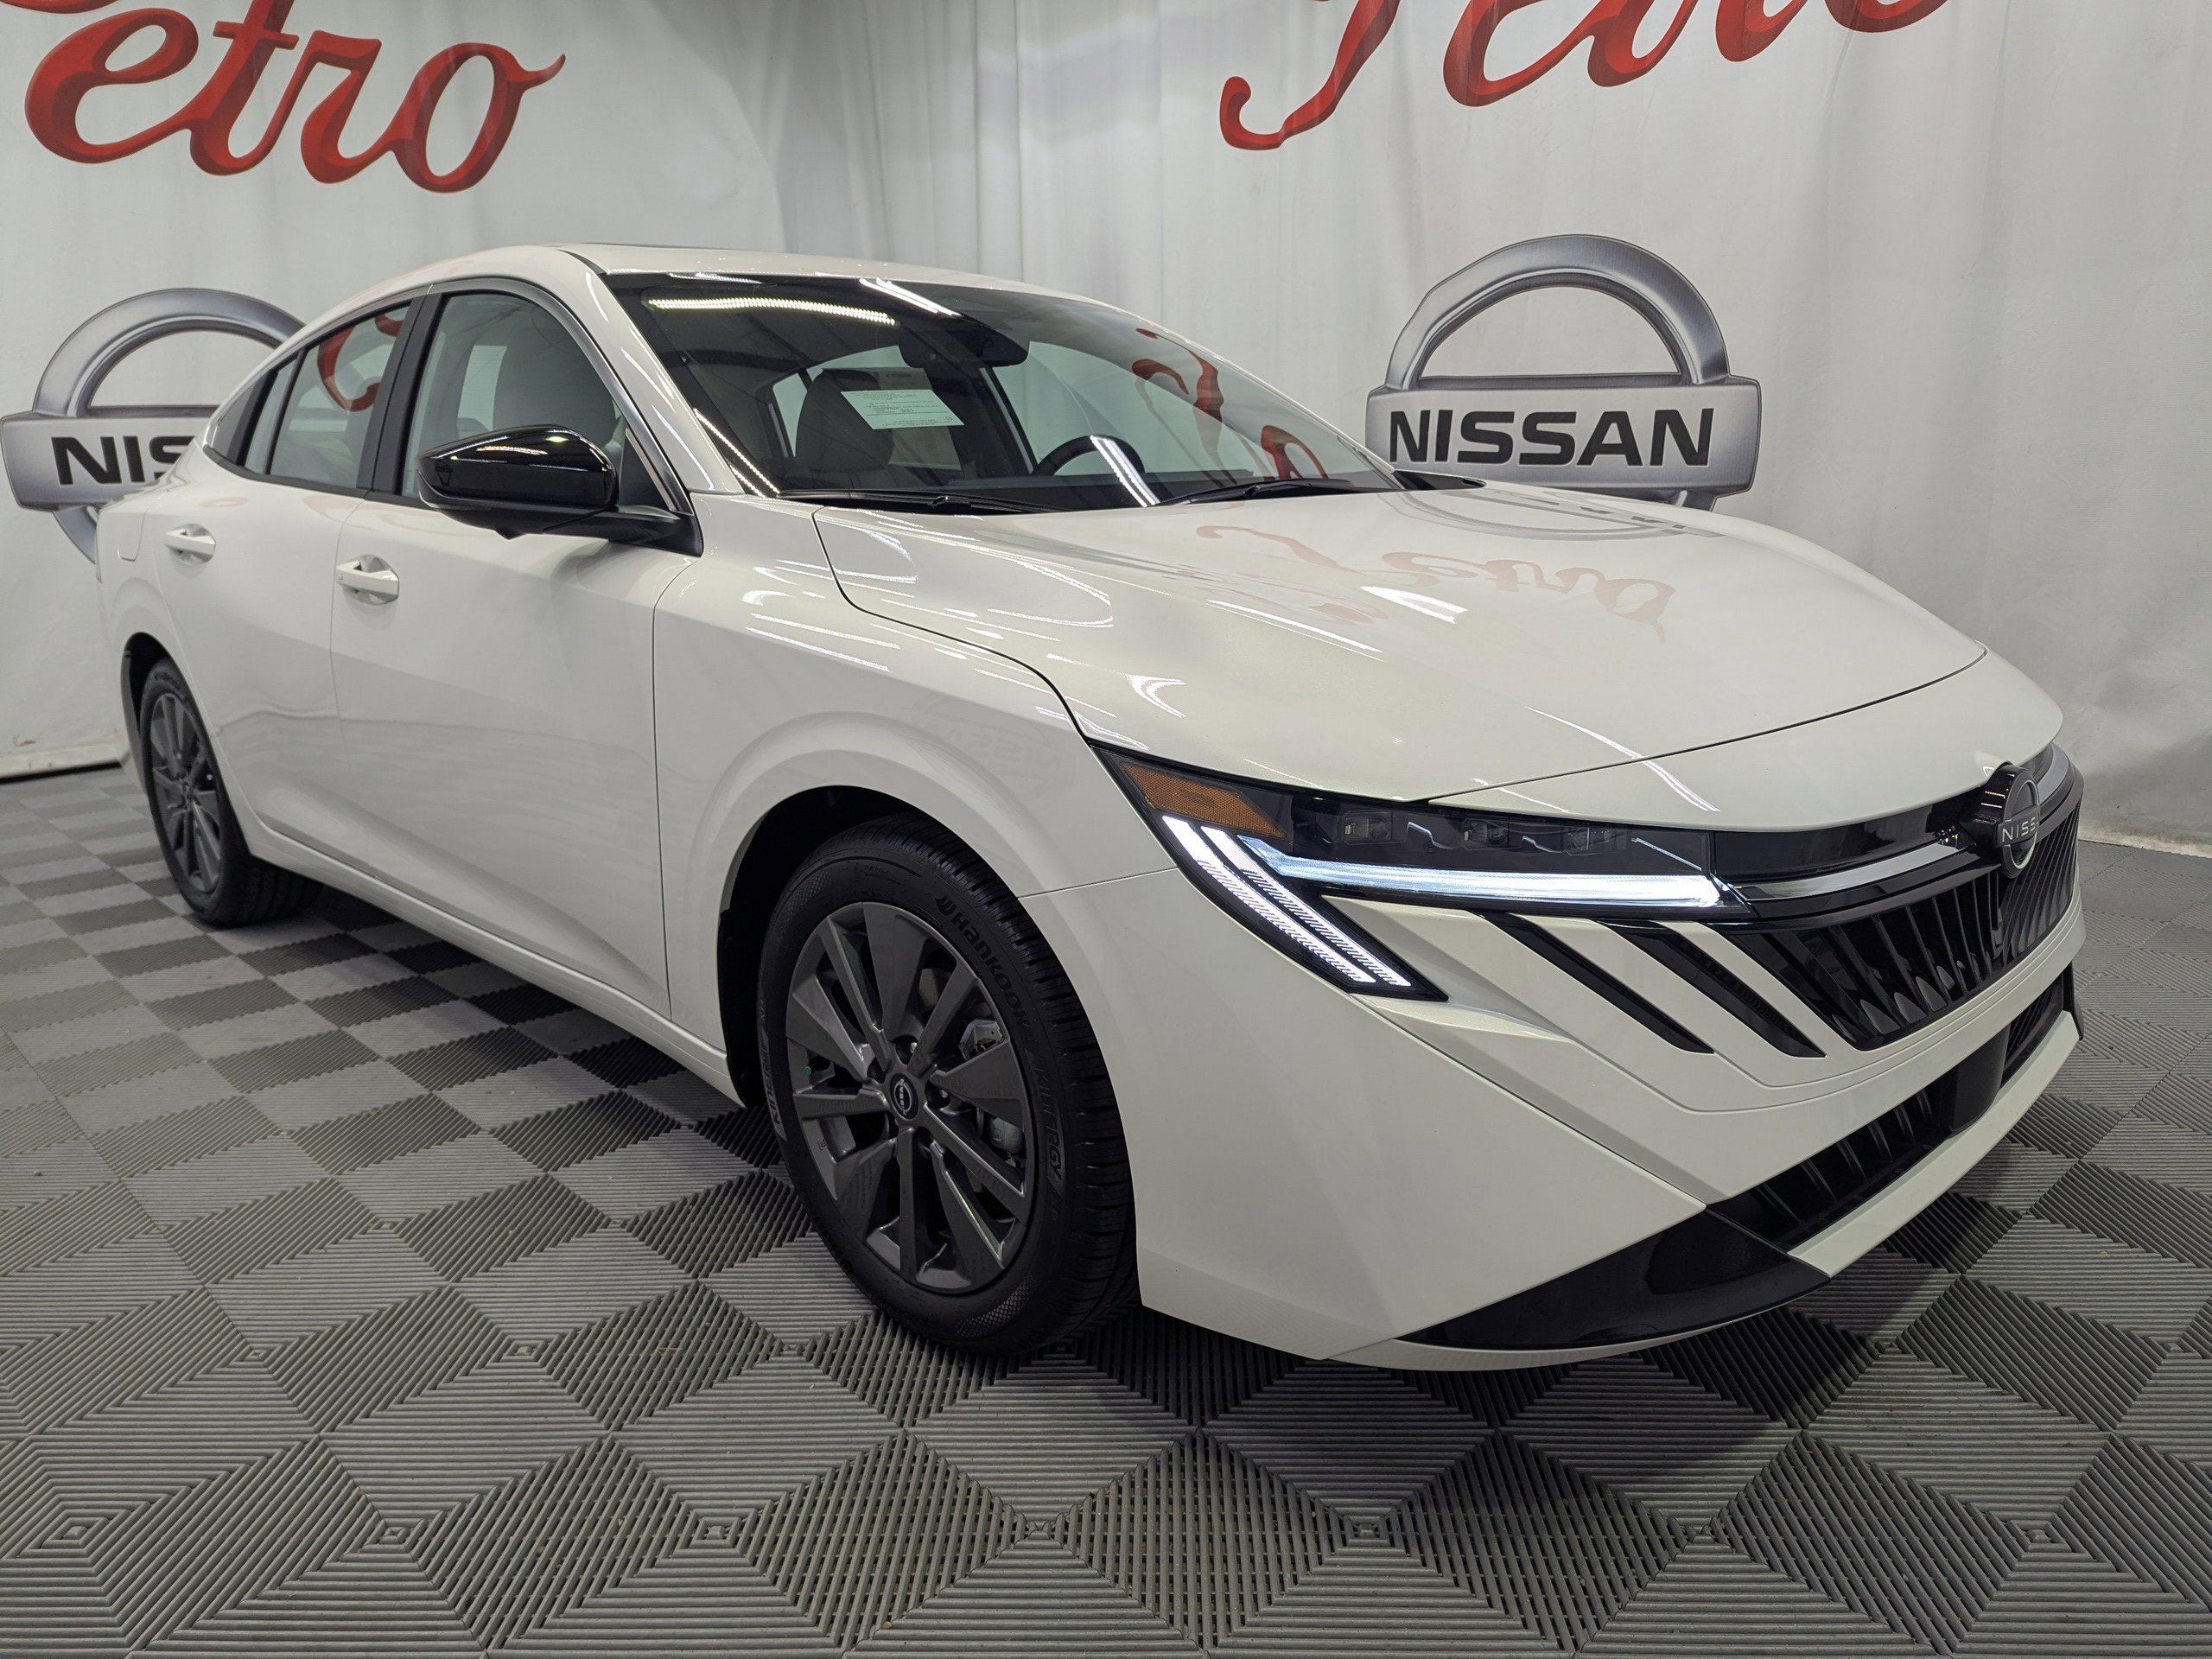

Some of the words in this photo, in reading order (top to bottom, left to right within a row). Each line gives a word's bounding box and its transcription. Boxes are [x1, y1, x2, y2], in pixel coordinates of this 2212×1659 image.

[0, 0, 566, 194] etro
[50, 435, 196, 486] NIS
[1389, 408, 1714, 467] NISSAN
[2001, 817, 2039, 843] NISS
